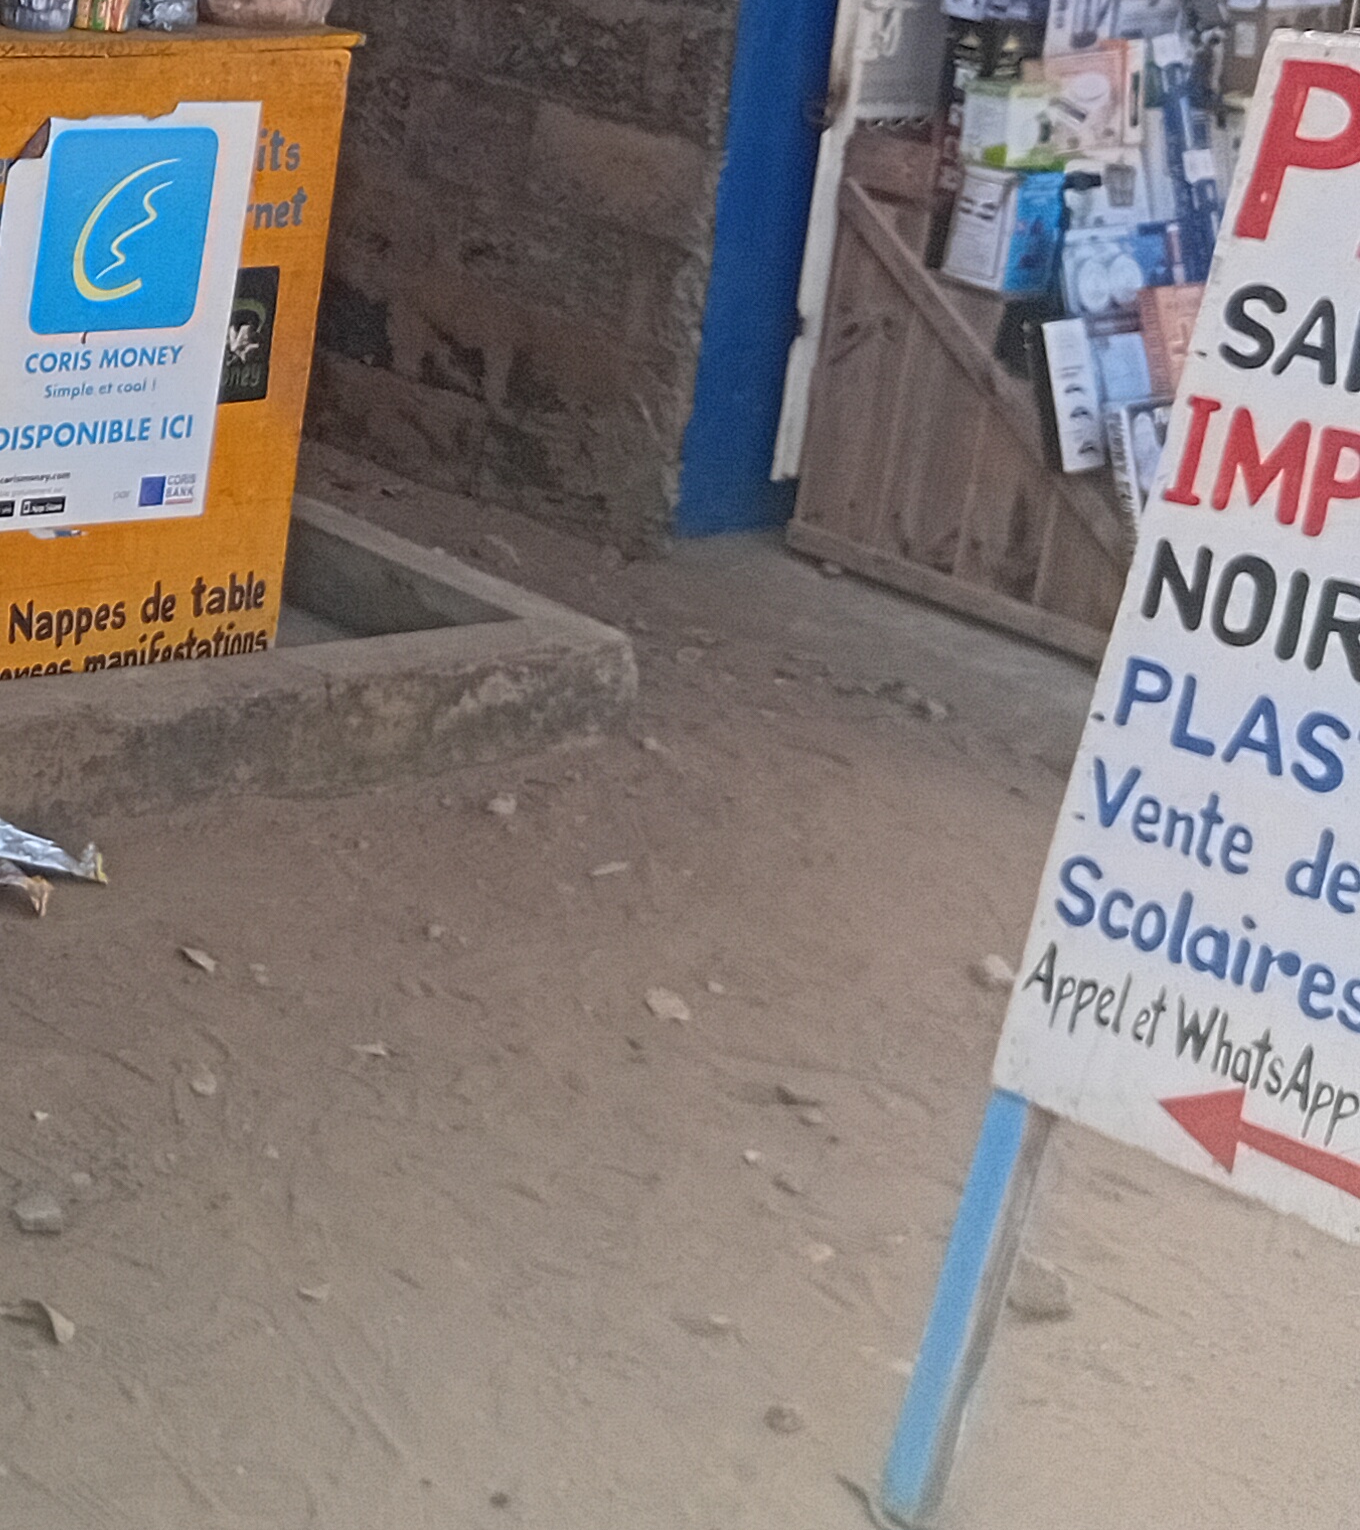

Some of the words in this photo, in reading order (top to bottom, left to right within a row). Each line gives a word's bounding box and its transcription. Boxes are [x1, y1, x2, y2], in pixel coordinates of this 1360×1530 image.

[24, 348, 92, 374] CORIS
[99, 344, 185, 370] MONEY
[43, 382, 94, 401] Simple
[98, 381, 113, 394] et
[117, 378, 147, 394] cool
[159, 413, 194, 440] ICI
[1161, 395, 1360, 537] IMP
[7, 599, 127, 648] Nappes
[140, 580, 175, 625] de
[191, 570, 266, 617] table
[1140, 537, 1360, 682] NOIR
[1113, 654, 1360, 794] PLAS
[1091, 756, 1254, 875] Vente
[1284, 826, 1360, 914] de
[1054, 853, 1360, 1034] Scolaires
[1021, 940, 1133, 1035] Appel
[1130, 983, 1167, 1046] et
[1175, 993, 1360, 1148] WhatsApp
